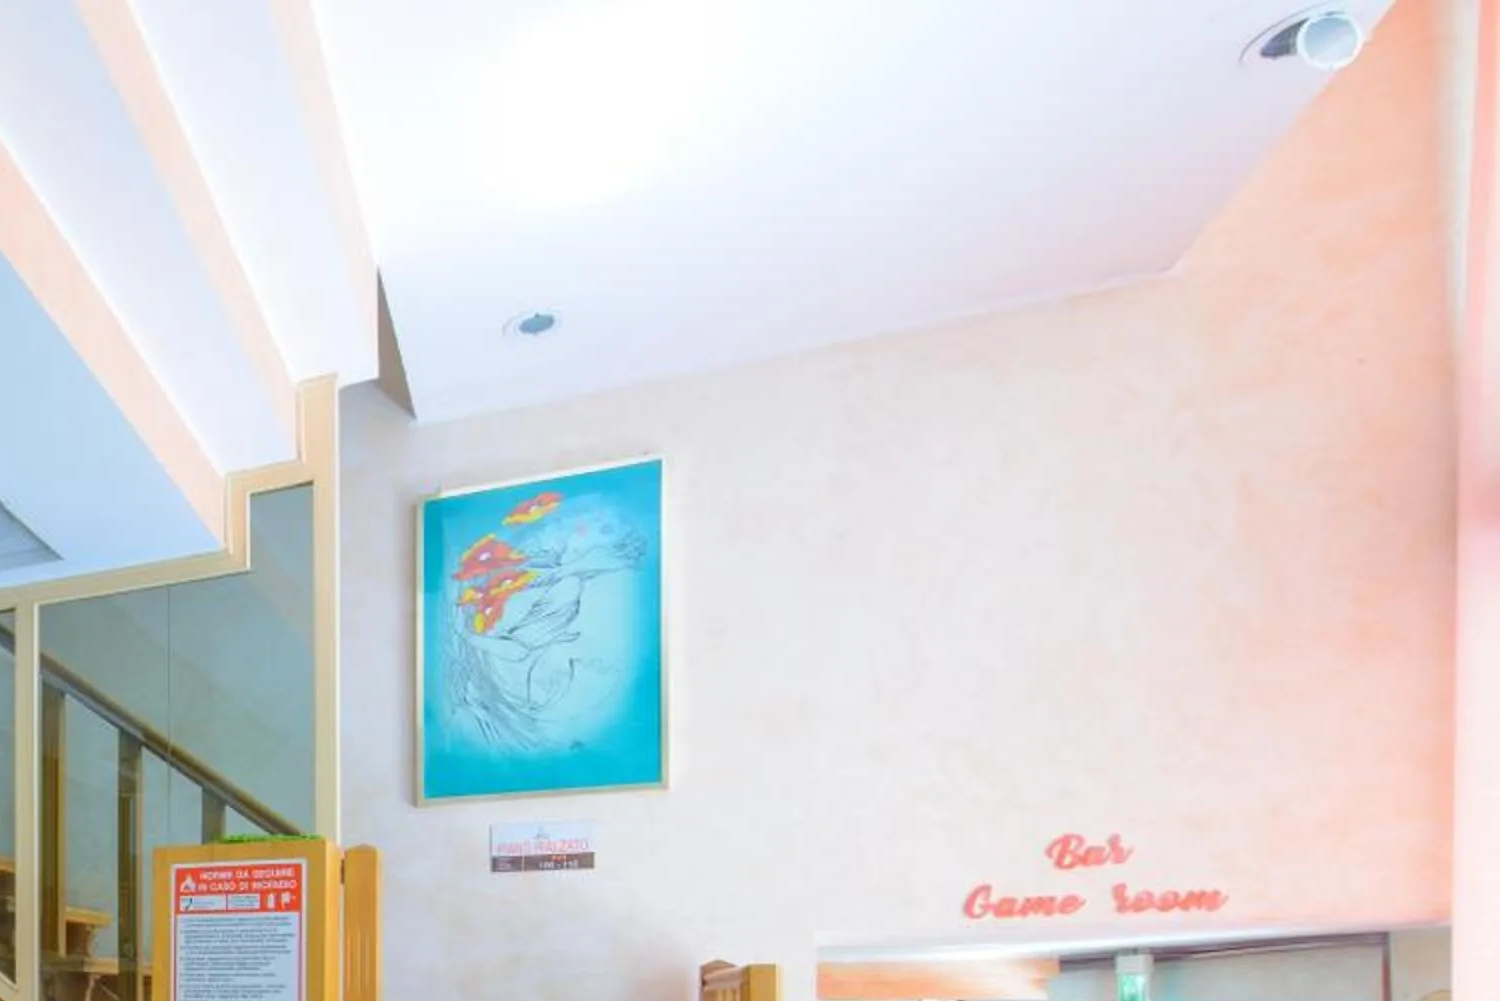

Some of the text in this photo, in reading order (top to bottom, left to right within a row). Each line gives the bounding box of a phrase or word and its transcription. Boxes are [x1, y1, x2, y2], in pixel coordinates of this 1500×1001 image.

[1045, 833, 1133, 869] Bar
[963, 883, 1229, 919] Game room
